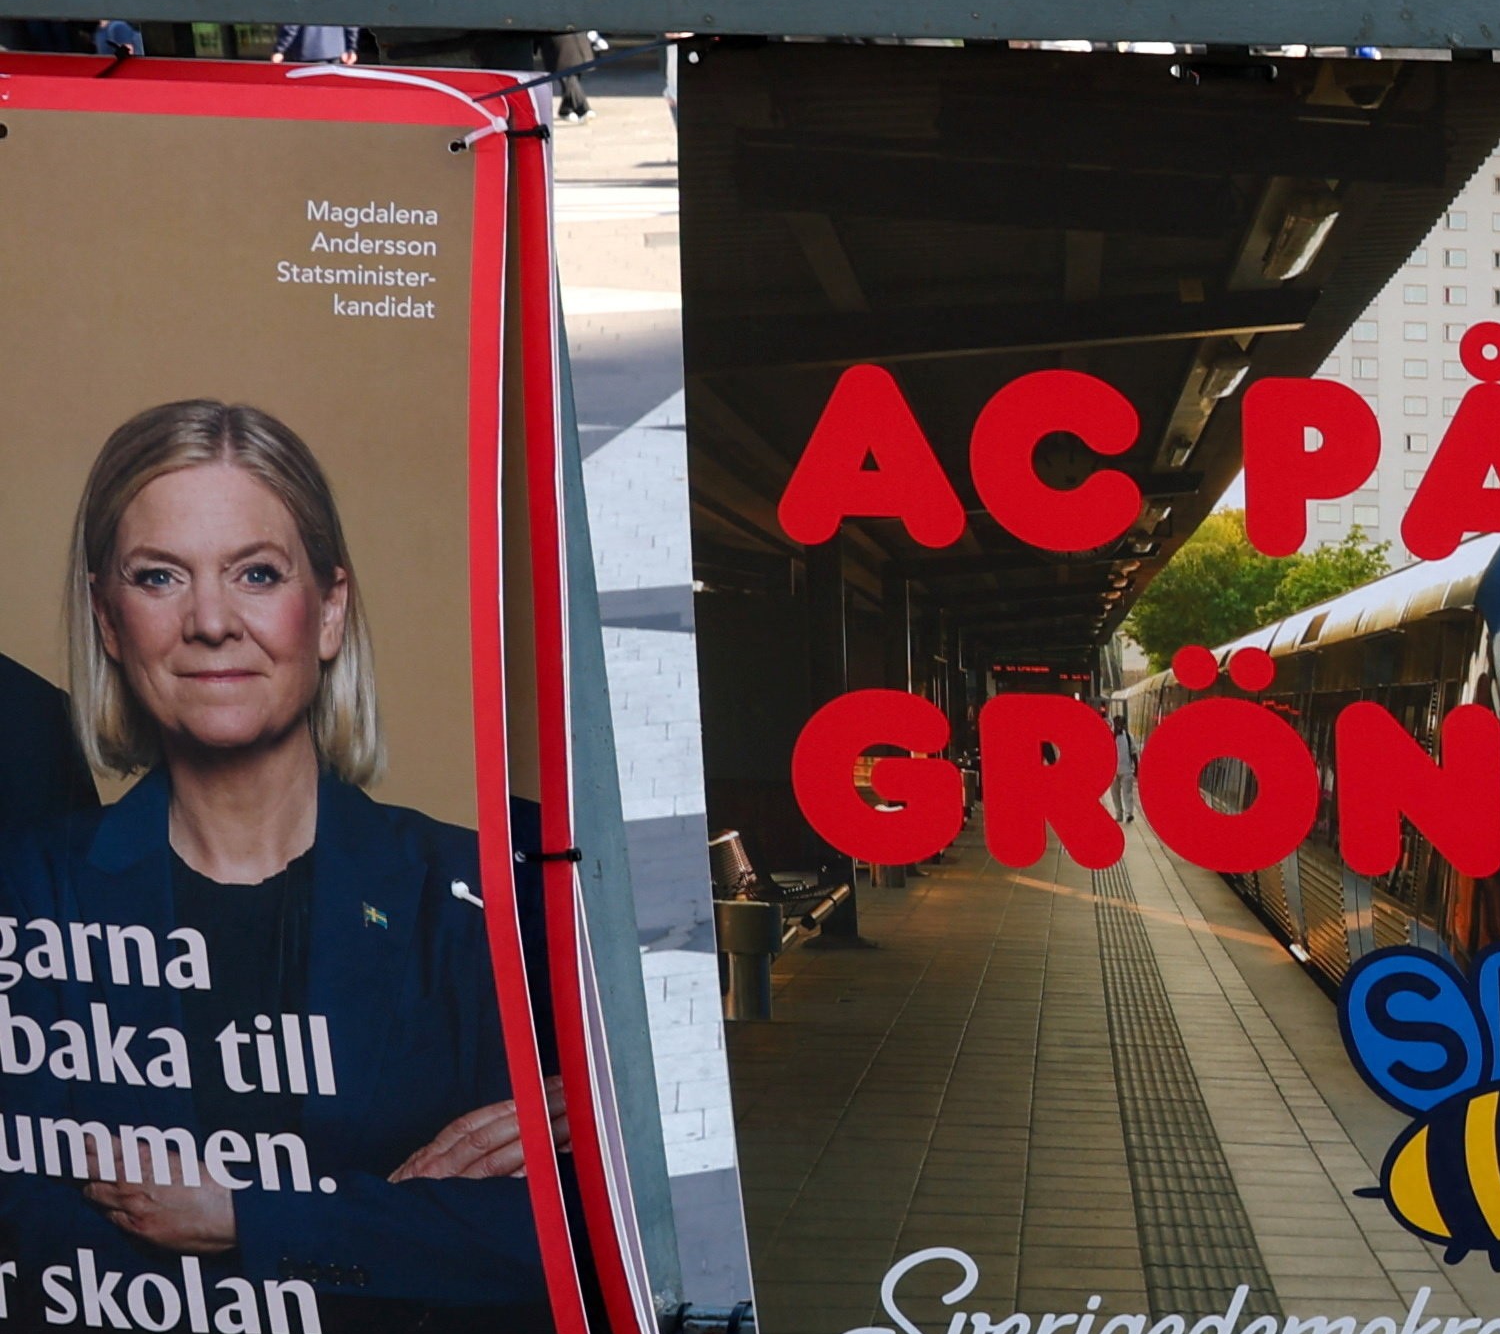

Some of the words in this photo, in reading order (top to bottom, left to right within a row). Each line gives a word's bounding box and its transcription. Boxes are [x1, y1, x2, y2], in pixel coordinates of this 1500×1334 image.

[306, 199, 439, 228] Magdalena
[311, 231, 437, 257] Andersson
[276, 261, 437, 287] Statsminister-
[333, 292, 436, 319] kandidat
[777, 362, 1142, 554] AC
[216, 1013, 337, 1096] till
